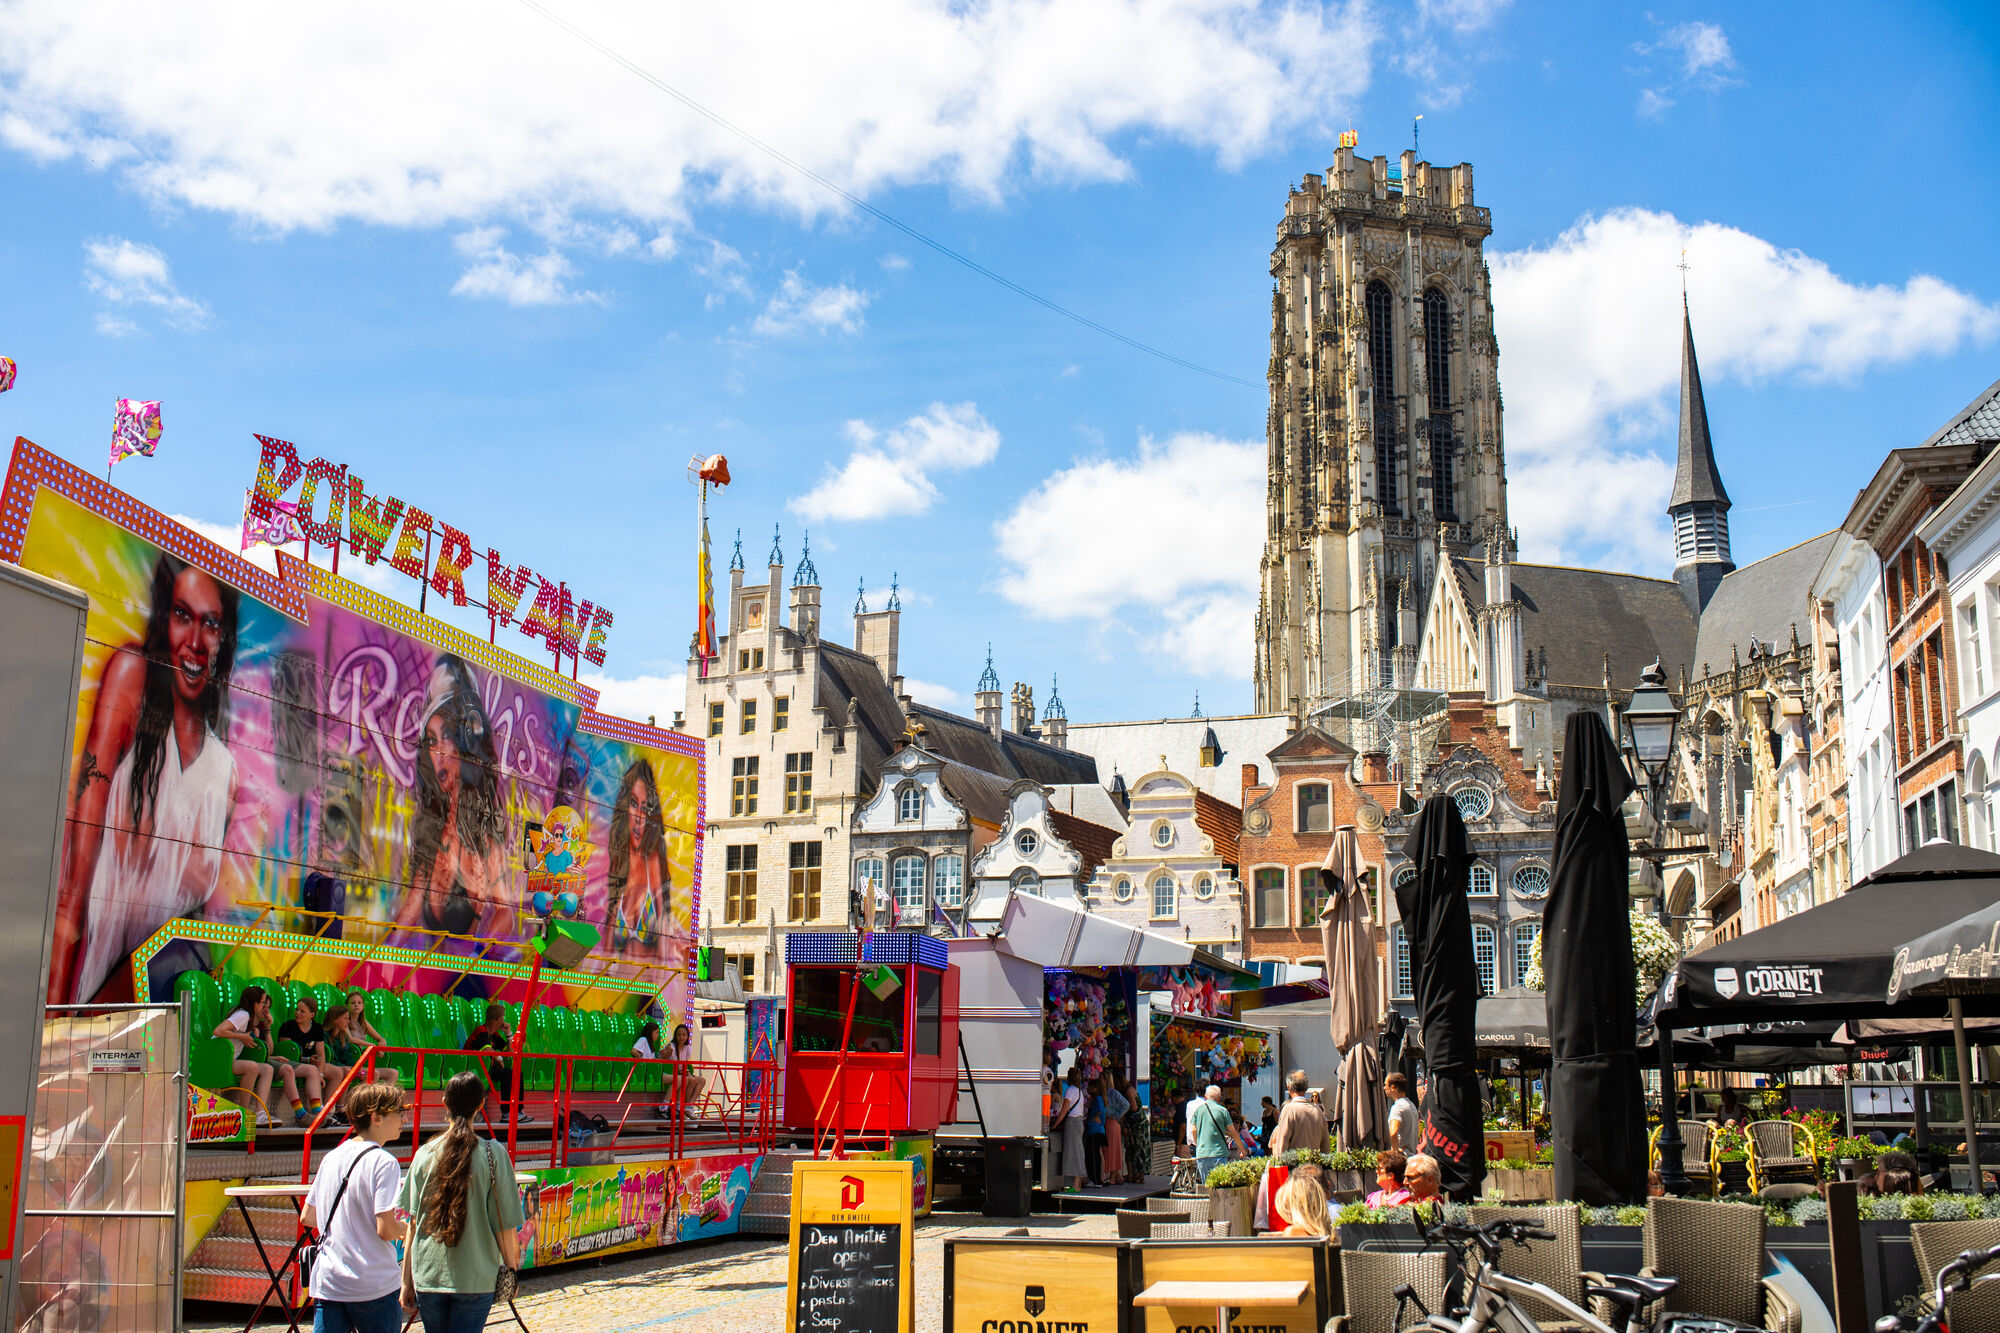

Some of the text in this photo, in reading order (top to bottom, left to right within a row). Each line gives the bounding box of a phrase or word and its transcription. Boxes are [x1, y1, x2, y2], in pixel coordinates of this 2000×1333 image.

[252, 433, 614, 668] POWER WAVE
[1745, 968, 1824, 996] CORNET
[1479, 1034, 1516, 1042] CAROLUS
[1860, 1049, 1889, 1060] Duvel
[190, 1112, 242, 1141] UITGANG
[539, 1180, 574, 1250] THE
[572, 1175, 620, 1237] PLACE
[619, 1172, 641, 1226] TO
[642, 1168, 666, 1226] BE
